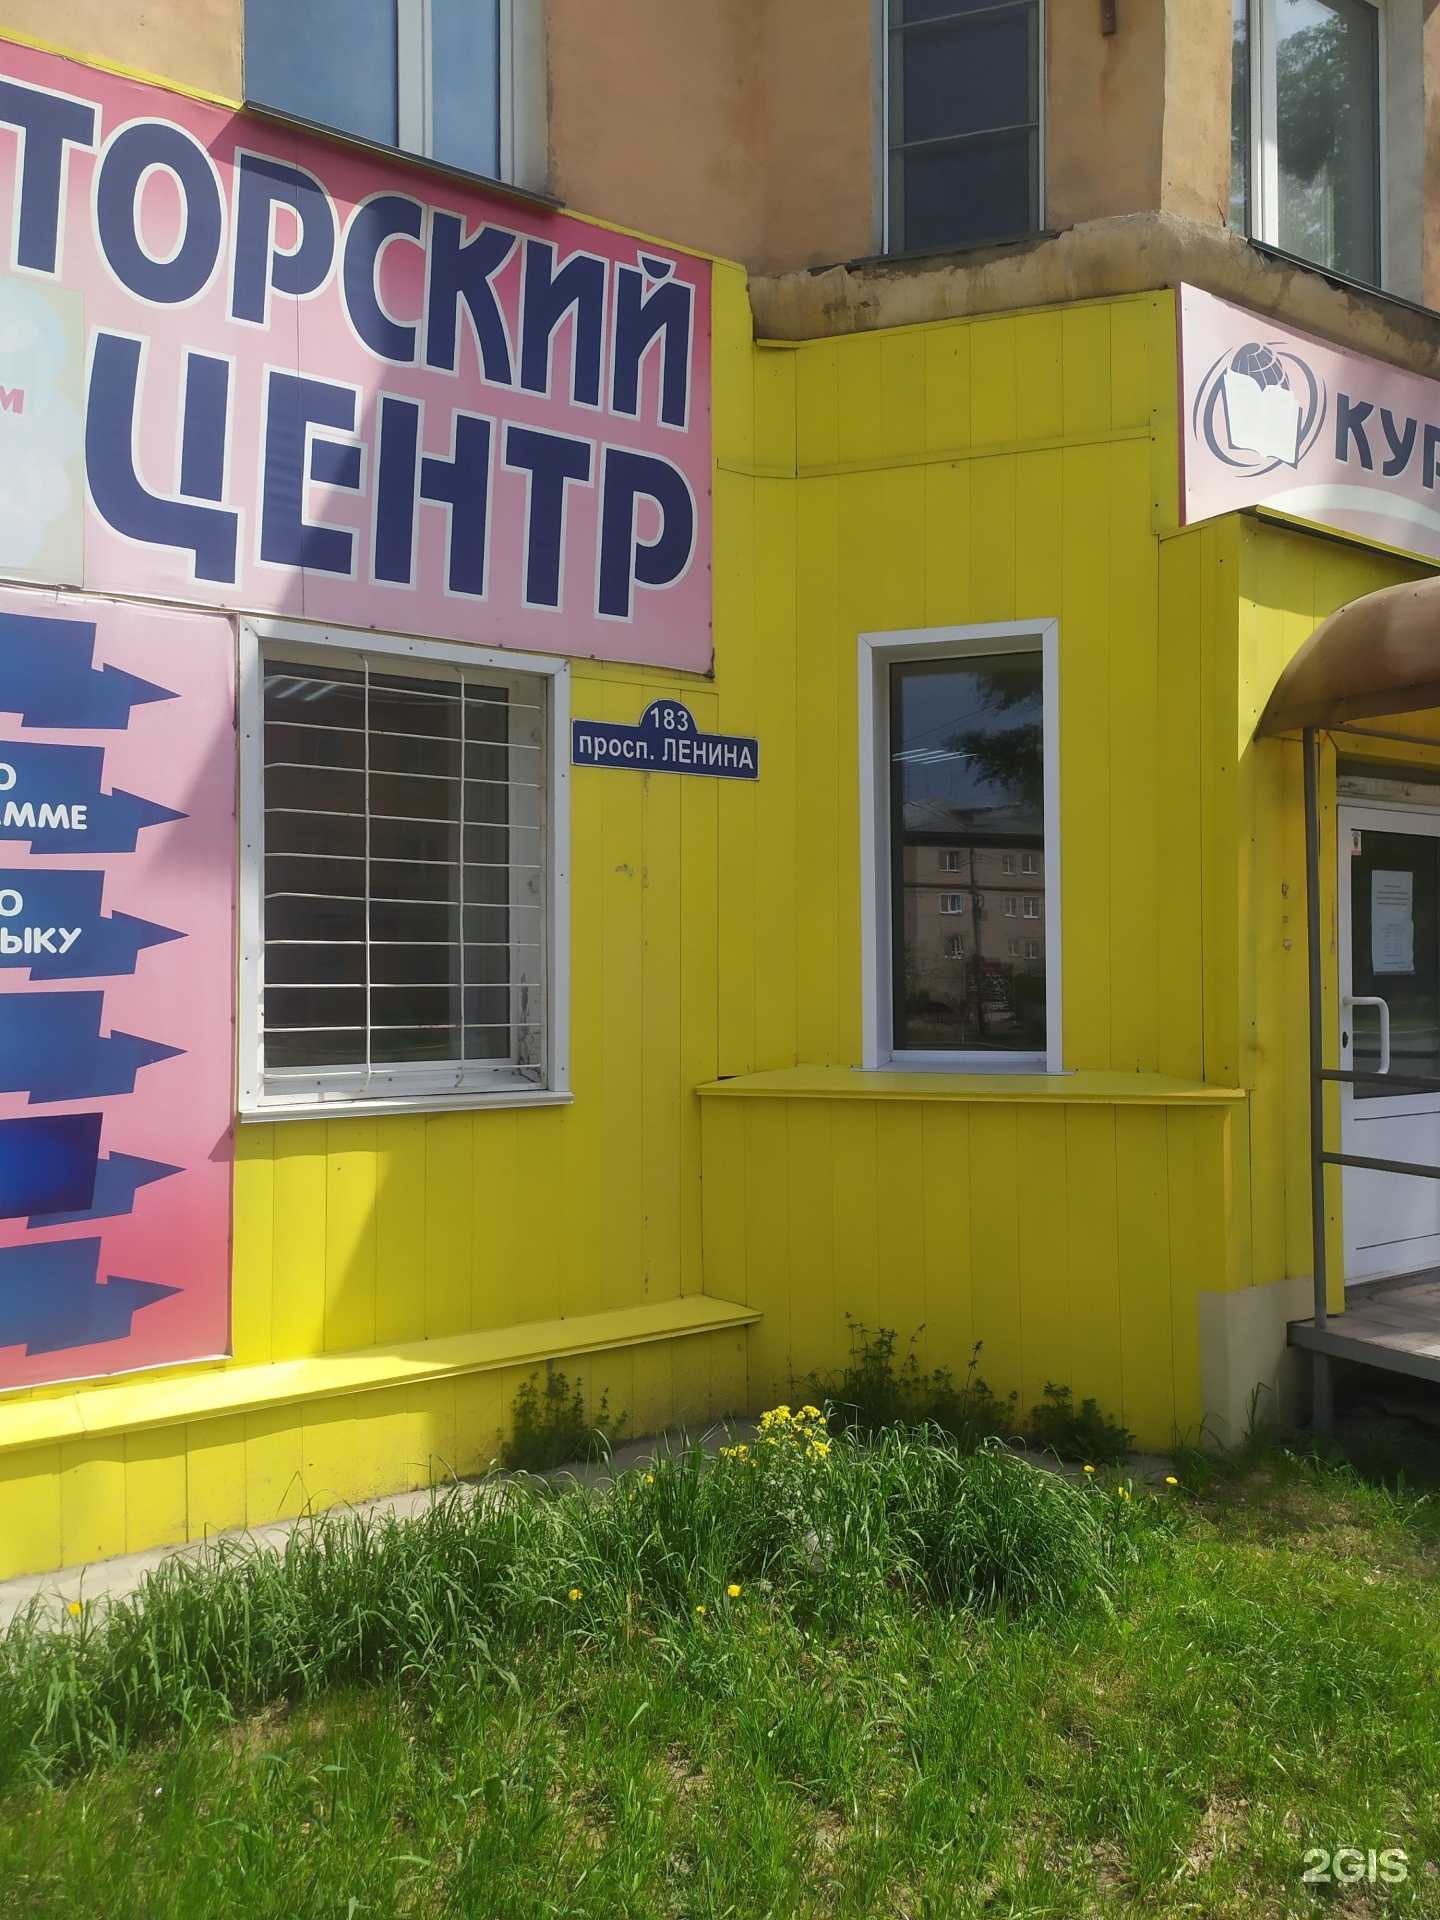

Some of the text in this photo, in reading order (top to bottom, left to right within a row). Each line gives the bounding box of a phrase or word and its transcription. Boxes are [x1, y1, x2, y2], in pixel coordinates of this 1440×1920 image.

[0, 73, 696, 432] ТОРСКИЙ
[85, 327, 697, 622] ЦЕНТР
[650, 707, 689, 732] 183
[579, 735, 754, 769] просп. ЛЕНИНА
[0, 801, 88, 830] ММЕ
